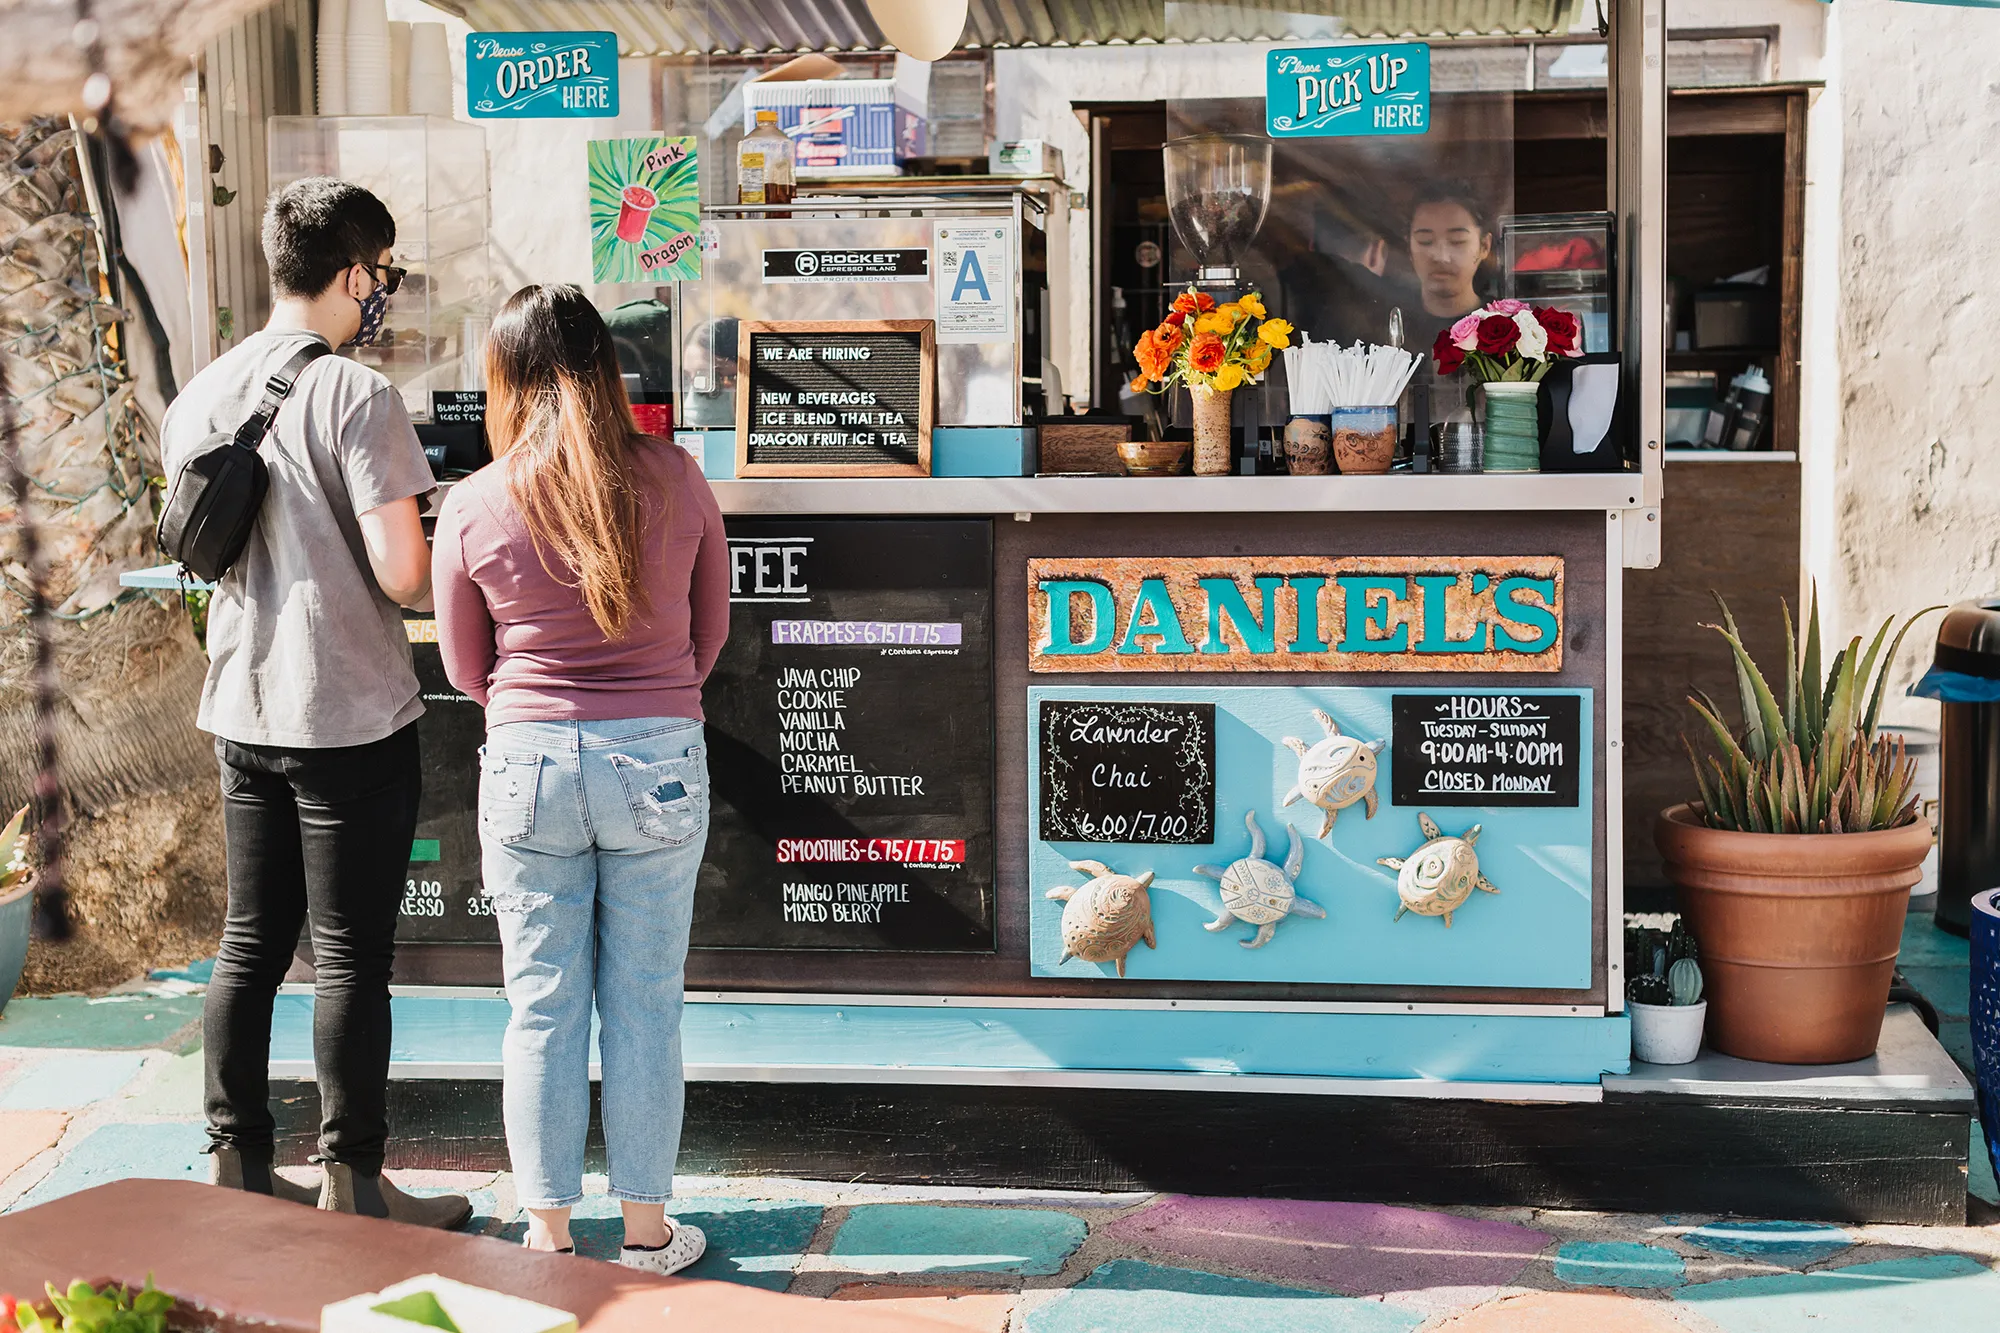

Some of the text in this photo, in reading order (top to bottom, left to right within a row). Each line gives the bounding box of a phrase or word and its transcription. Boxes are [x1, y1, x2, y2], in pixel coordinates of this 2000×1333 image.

[476, 39, 526, 60] Please
[496, 48, 592, 99] ORDER
[1278, 56, 1322, 74] Please
[1297, 52, 1408, 119] PICK UP
[562, 86, 610, 109] HERE
[1374, 104, 1423, 128] HERE
[646, 145, 684, 171] Pink
[641, 233, 694, 270] Dragon
[821, 254, 896, 263] ROCKET
[951, 250, 991, 301] A
[763, 347, 870, 360] WE ARE HIRING
[455, 392, 478, 400] NEW
[761, 392, 876, 405] NEW BEVERAGES
[463, 404, 486, 412] ORAN
[762, 413, 904, 424] ICE BLEND THAI TEA
[749, 433, 907, 446] DRAGON FRUIT ICE TEA
[731, 547, 808, 593] FEE
[1036, 574, 1558, 655] DANIEL'S
[777, 668, 861, 689] JAVA CHIP
[777, 690, 847, 710] COOKIE
[779, 711, 846, 730] VANILLA
[1069, 715, 1178, 744] Lavender
[780, 731, 840, 752] MOCHA
[781, 753, 863, 773] CARAMEL
[781, 775, 925, 797] PEANUT BUTTER
[1092, 763, 1151, 788] Chai
[1082, 810, 1187, 841] 6.00/7.00
[406, 879, 442, 898] 3.00
[783, 883, 910, 902] MANGO PINEAPPLE
[783, 903, 883, 924] MIXED BERRY
